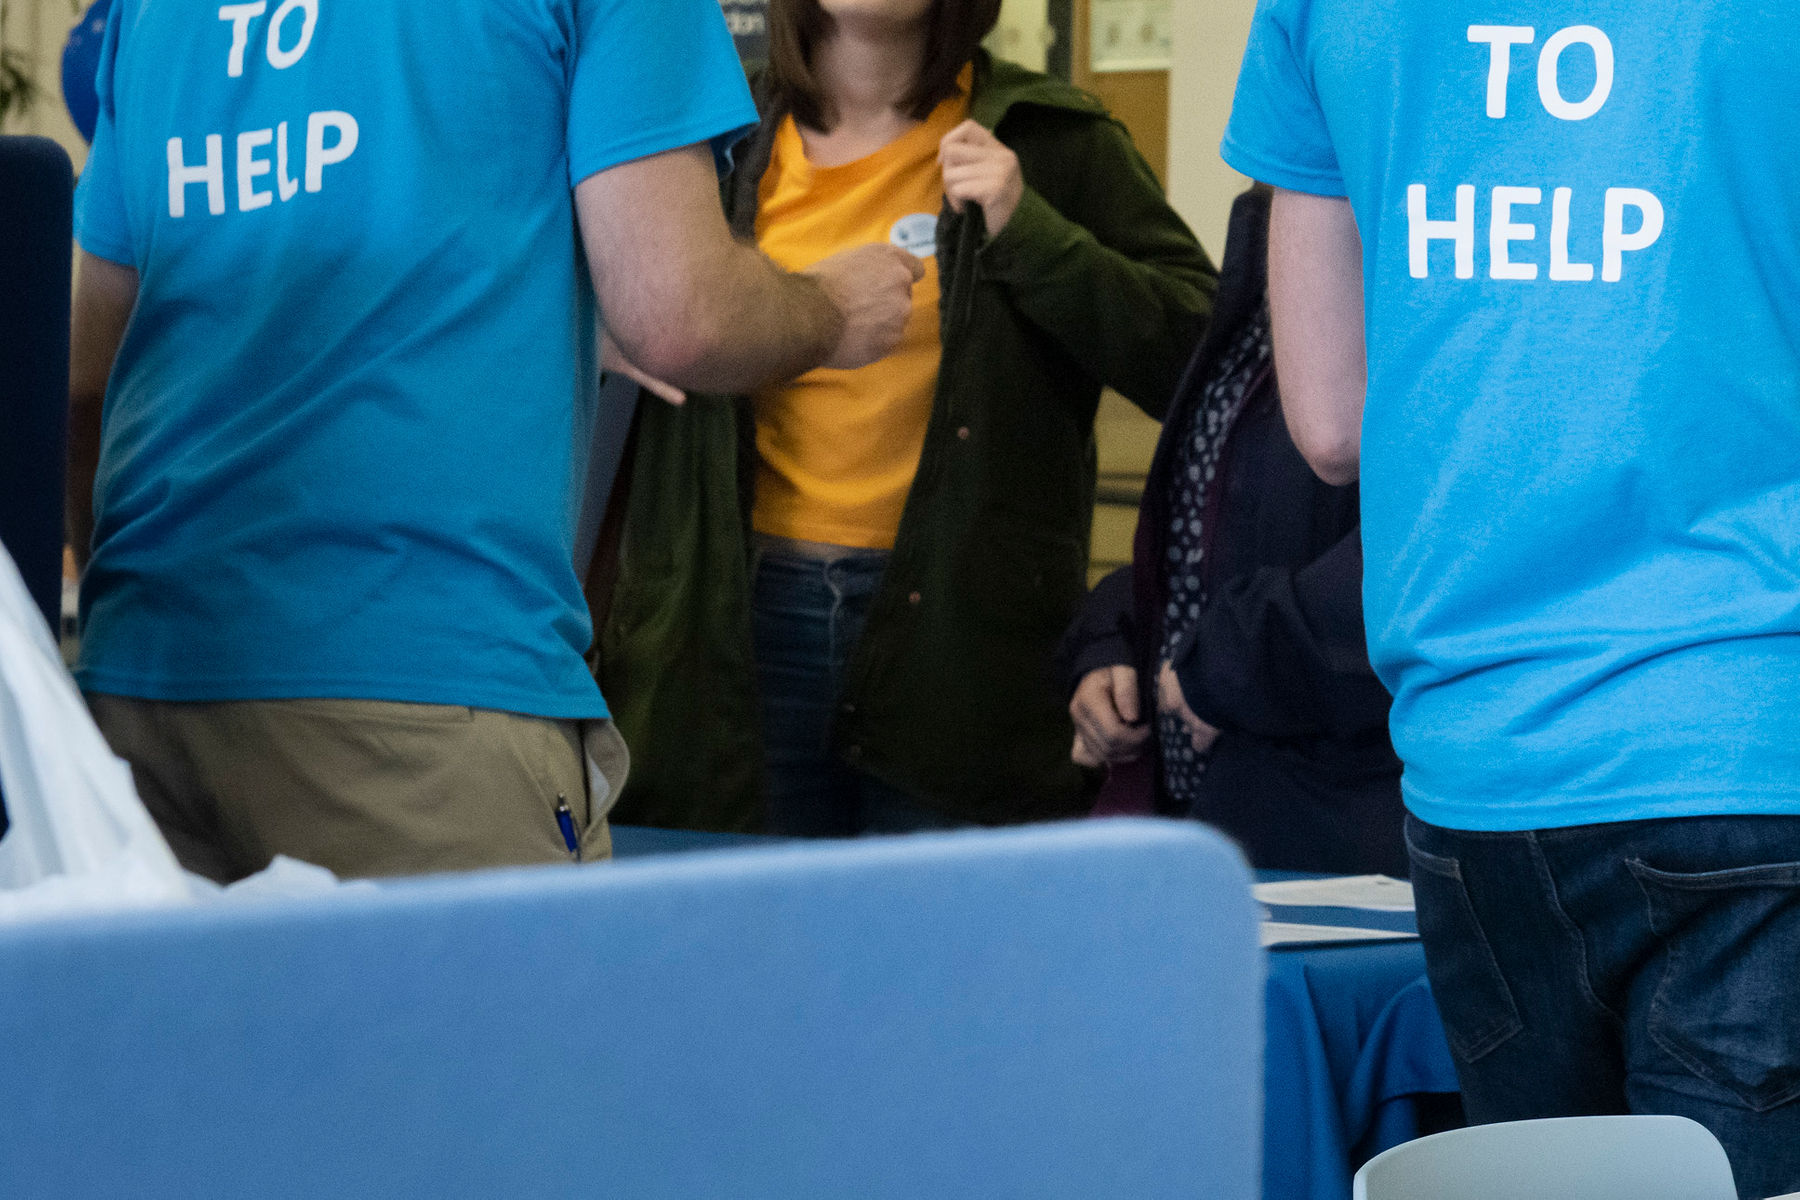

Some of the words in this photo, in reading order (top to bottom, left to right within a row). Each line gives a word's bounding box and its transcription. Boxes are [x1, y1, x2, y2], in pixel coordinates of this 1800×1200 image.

[1466, 24, 1615, 122] TO
[166, 110, 360, 218] HELP
[1406, 183, 1666, 284] HELP
